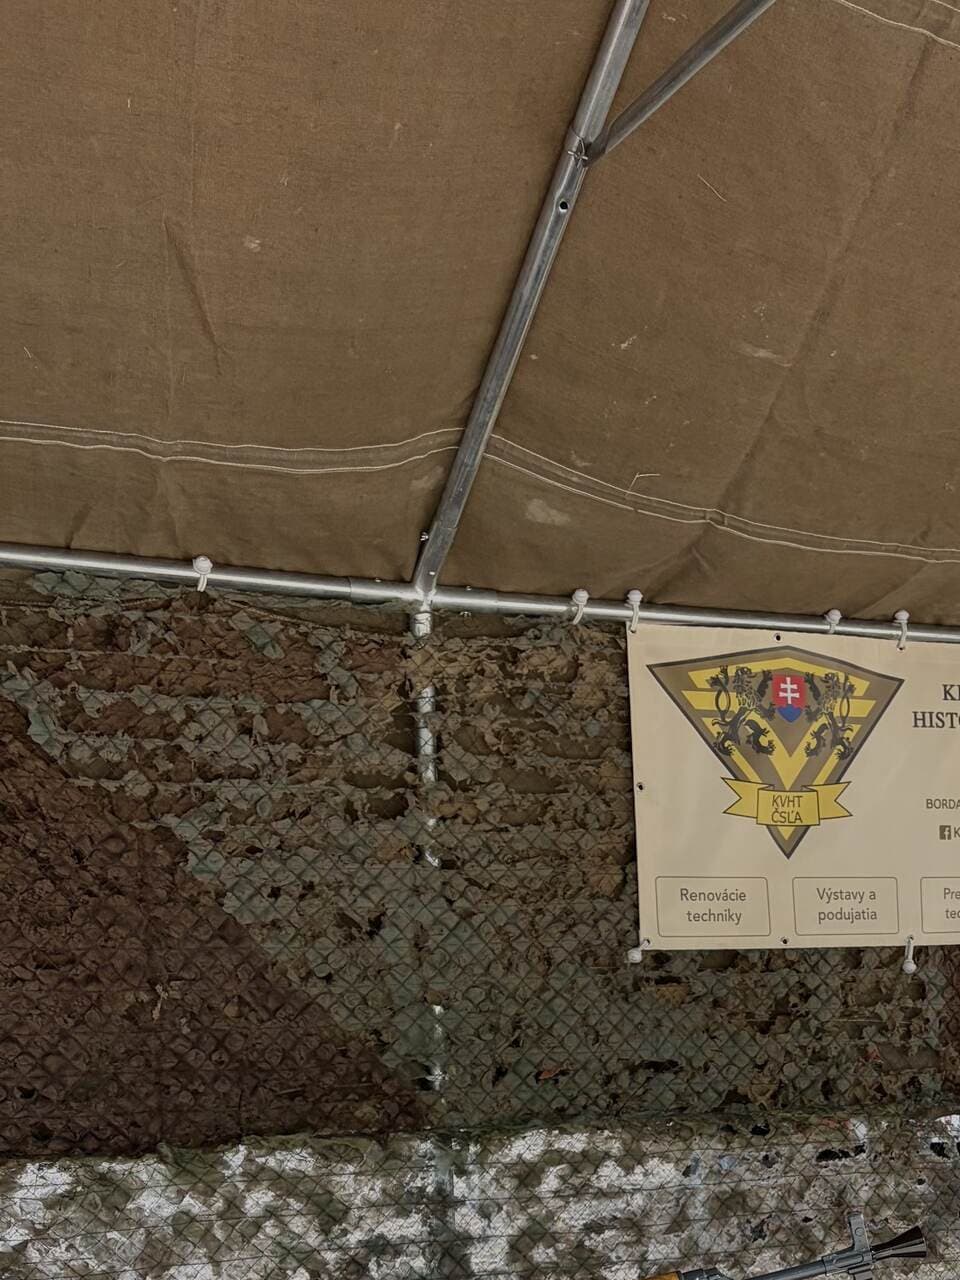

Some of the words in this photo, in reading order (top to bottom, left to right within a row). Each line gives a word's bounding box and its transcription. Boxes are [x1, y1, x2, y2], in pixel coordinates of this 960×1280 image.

[772, 795, 804, 808] KVHT
[771, 808, 804, 824] ČSĽA
[679, 887, 747, 902] Renovácie
[816, 887, 865, 904] Výstavy
[868, 889, 877, 901] a
[686, 908, 742, 925] techniky
[817, 906, 878, 924] podujatia
